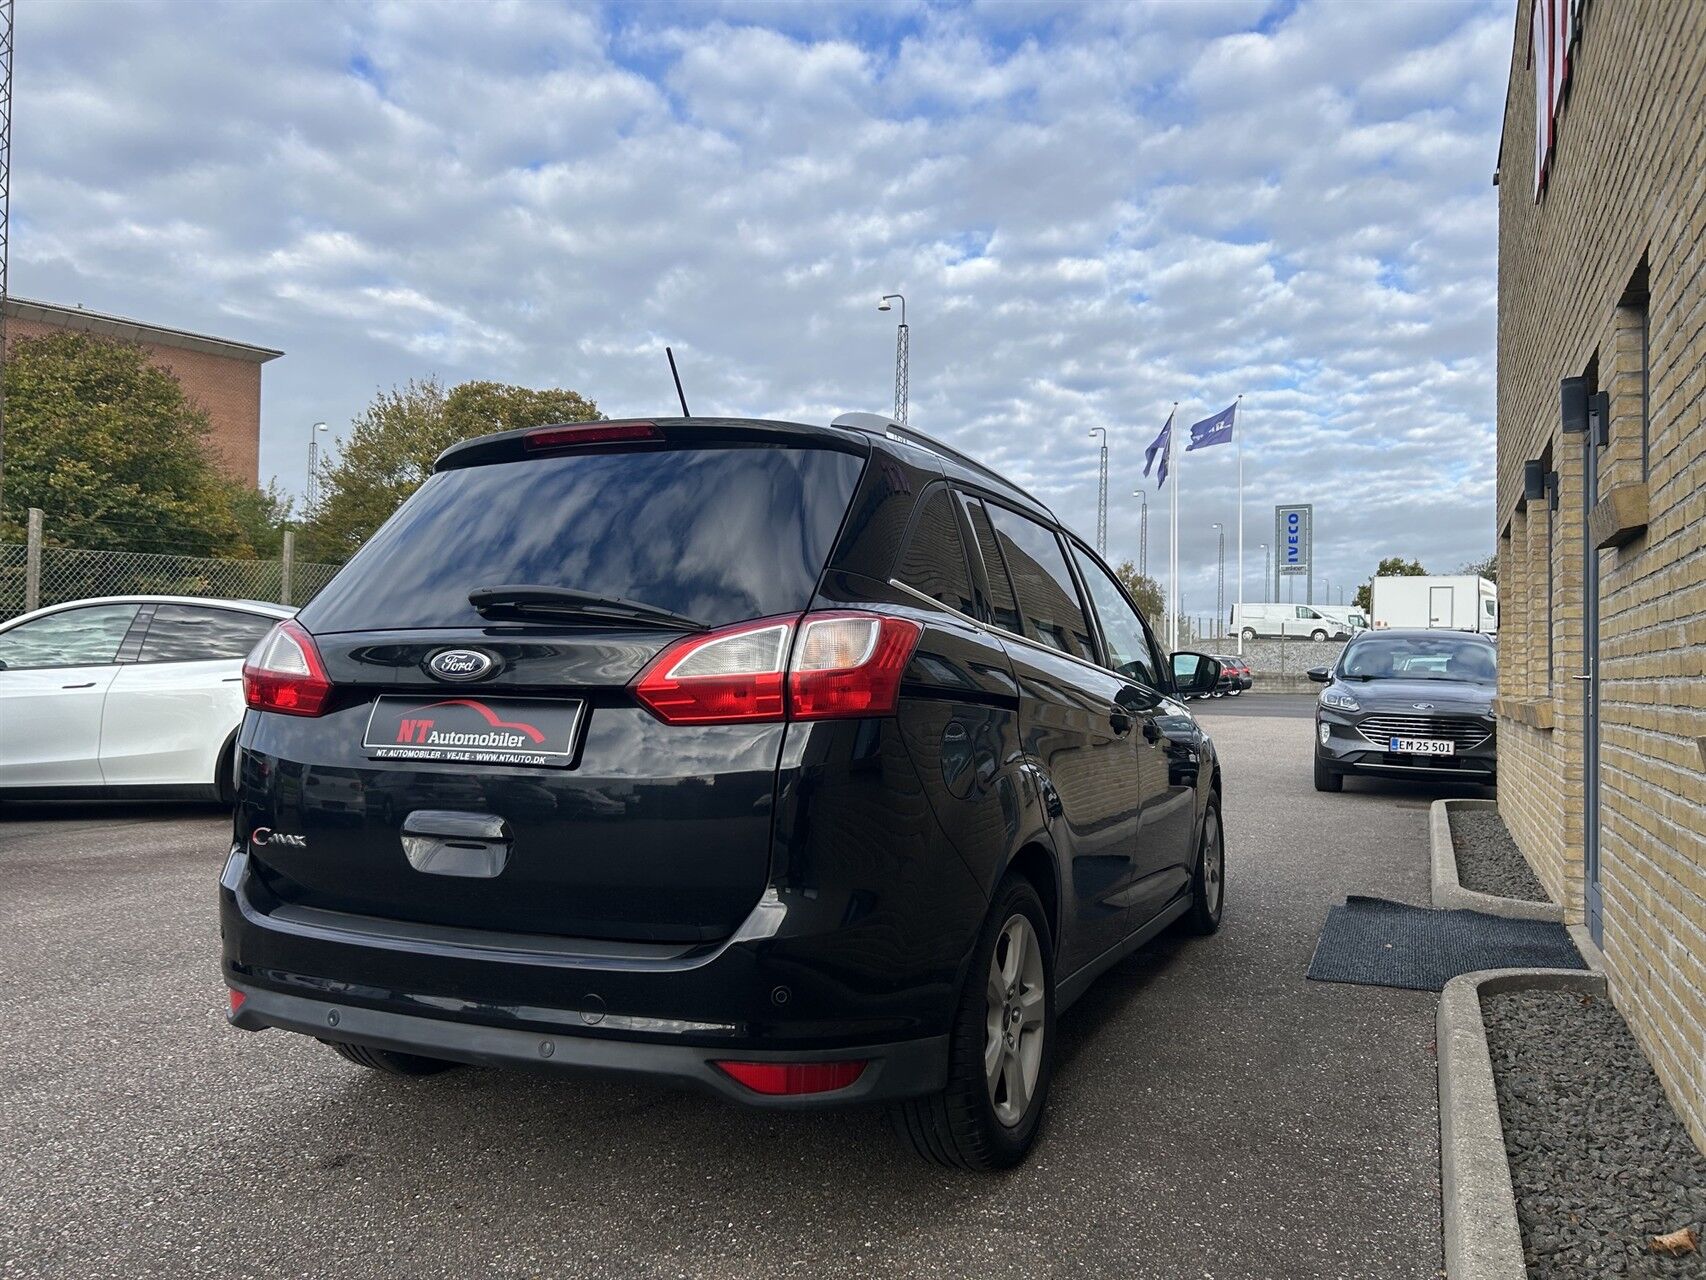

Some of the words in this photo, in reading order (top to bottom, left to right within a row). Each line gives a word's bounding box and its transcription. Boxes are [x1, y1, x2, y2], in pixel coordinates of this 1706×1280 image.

[1288, 513, 1299, 563] IVECO
[441, 654, 476, 671] Ford
[396, 719, 434, 744] NT
[427, 731, 526, 747] Automobiler
[1400, 740, 1413, 751] EM
[1416, 741, 1429, 751] 25
[1432, 742, 1451, 753] 501
[388, 749, 441, 759] AUTOMOBILER
[446, 751, 470, 760] VEJLE
[476, 753, 546, 764] WWW.NTAUTO.DK
